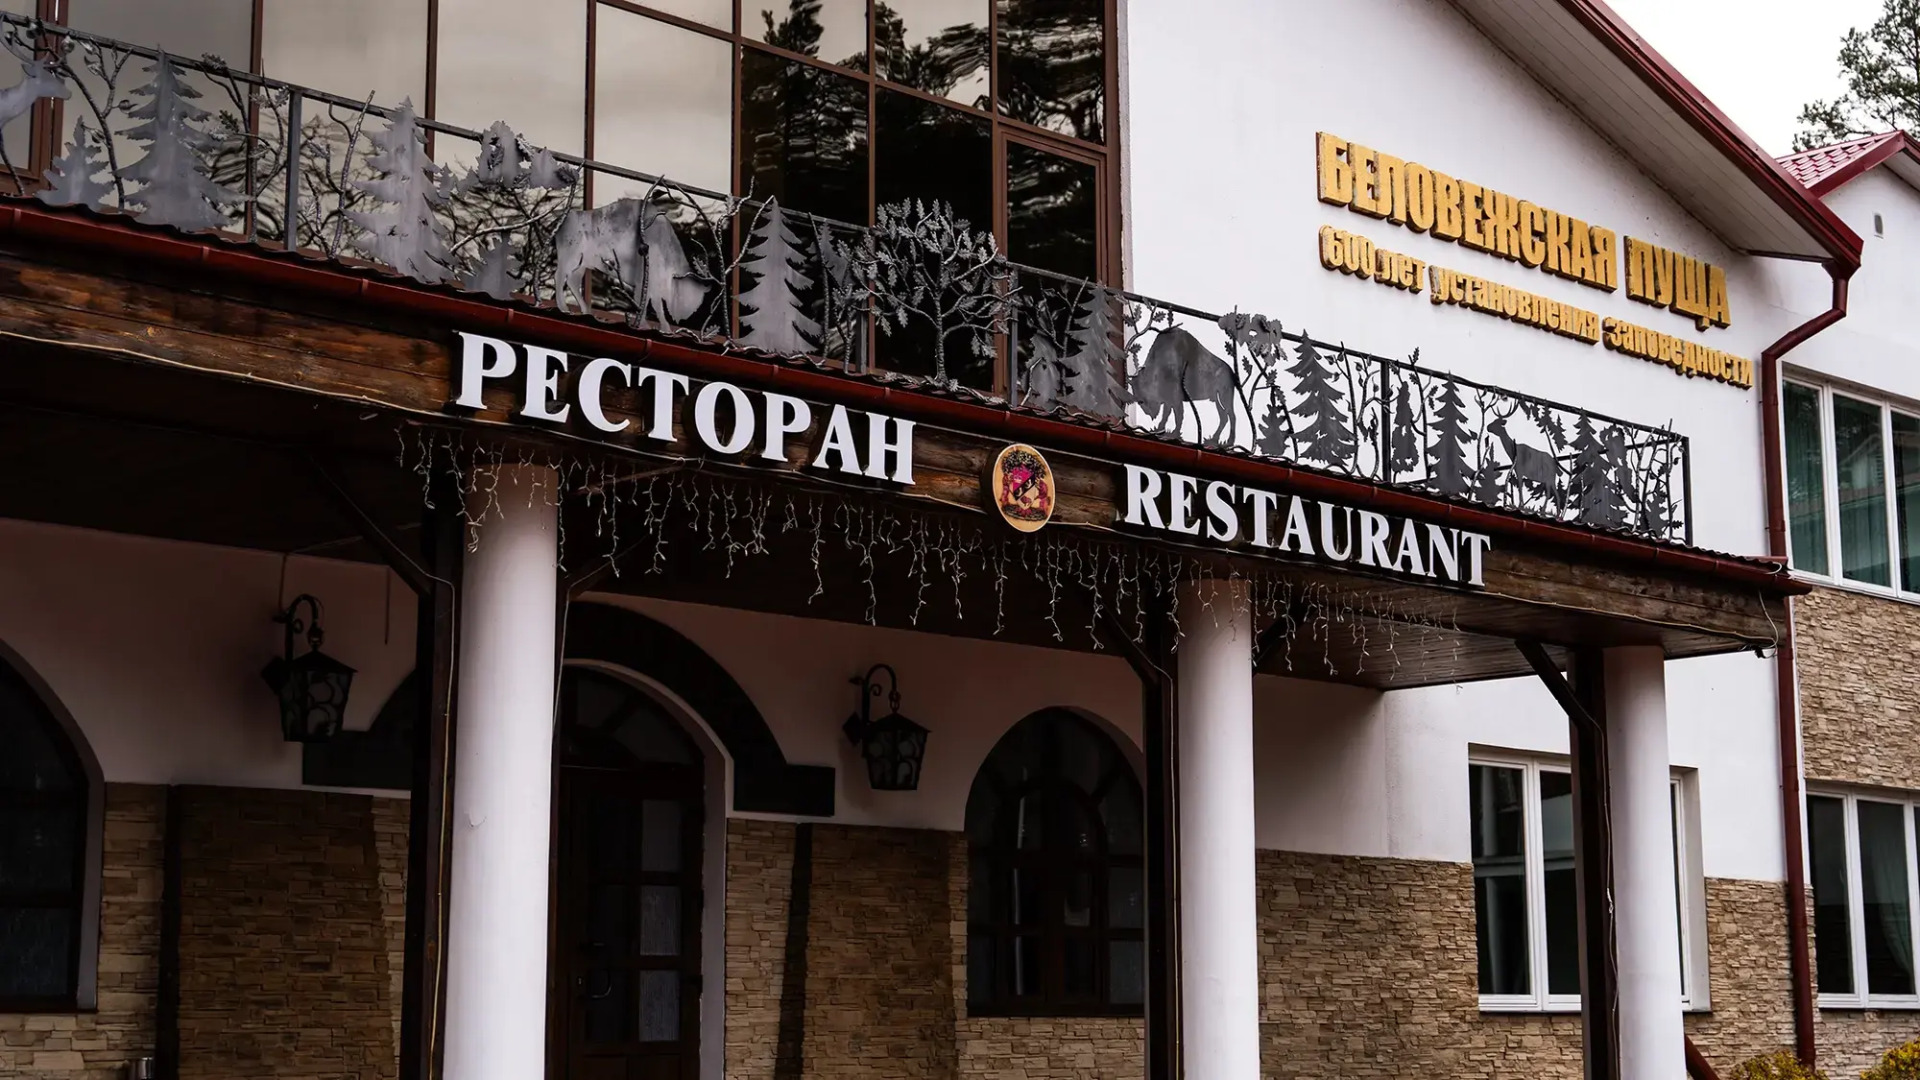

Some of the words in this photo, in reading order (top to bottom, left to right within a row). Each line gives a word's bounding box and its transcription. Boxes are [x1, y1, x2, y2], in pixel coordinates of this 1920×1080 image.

[1317, 132, 1618, 291] БЕЛОВЕЖСКАЯ
[1625, 236, 1732, 330] ПУЩА
[1320, 225, 1375, 278] 600
[1375, 248, 1426, 292] лет
[1430, 266, 1600, 344] установления
[1603, 317, 1754, 389] заповедности
[455, 331, 917, 485] РЕСТОРАН
[1122, 463, 1492, 587] RESTAURANT
